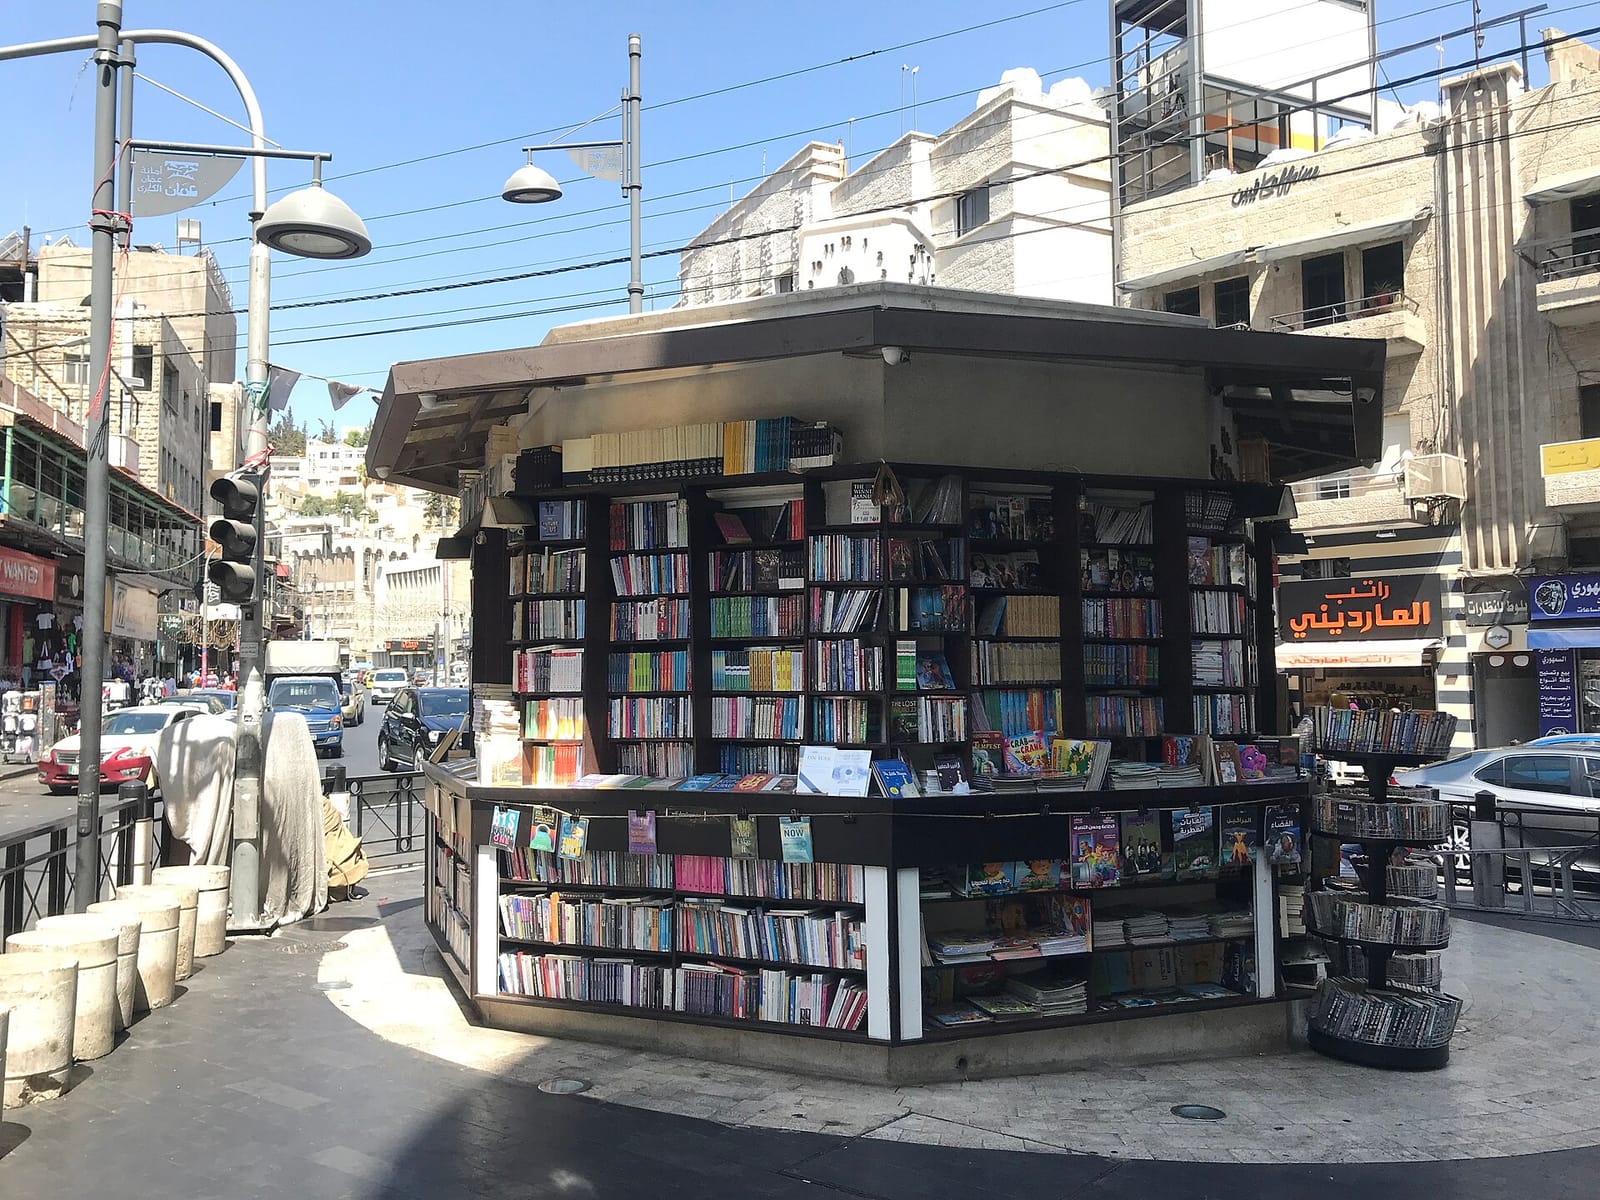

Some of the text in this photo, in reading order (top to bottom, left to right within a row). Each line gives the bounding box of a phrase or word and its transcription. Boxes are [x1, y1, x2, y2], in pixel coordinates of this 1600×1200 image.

[4, 560, 38, 585] WANTED
[1324, 579, 1390, 605] راتب
[1289, 601, 1431, 638] المارديني
[1010, 737, 1029, 748] CRAB
[1020, 743, 1043, 754] CRANE
[783, 829, 804, 838] NOW
